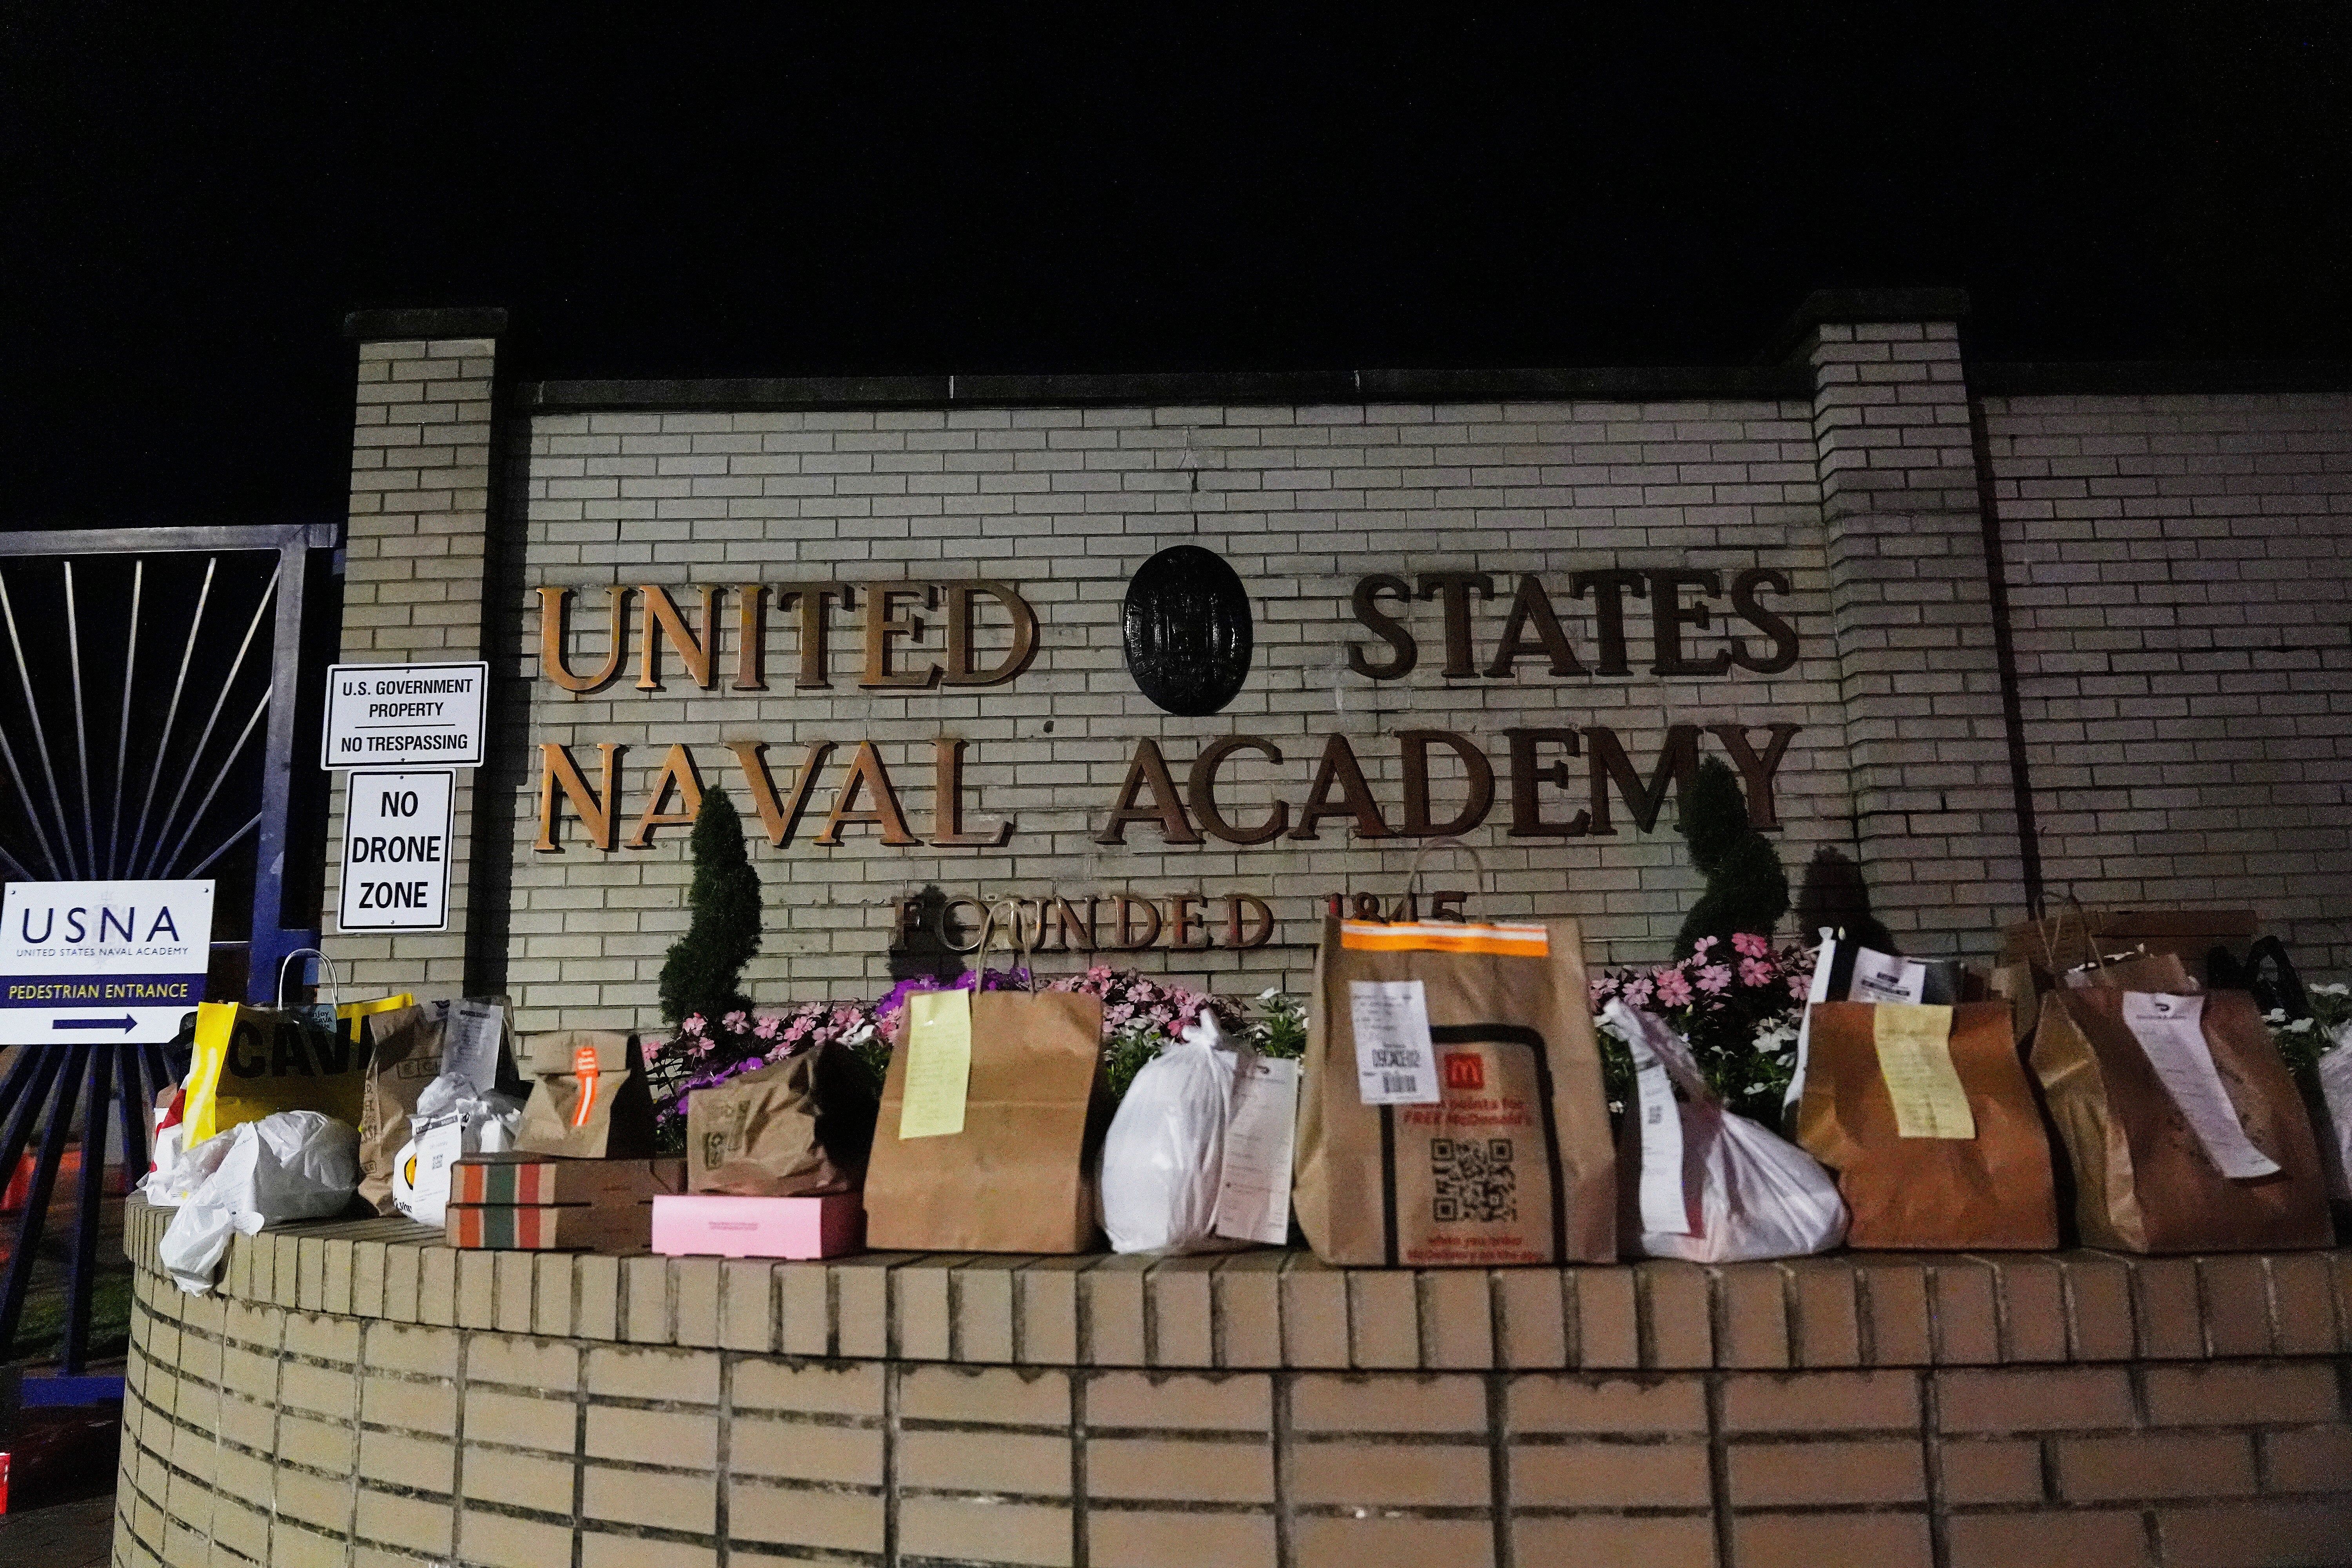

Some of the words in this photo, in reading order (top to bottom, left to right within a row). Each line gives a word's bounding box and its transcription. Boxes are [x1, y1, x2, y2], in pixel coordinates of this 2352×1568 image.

[537, 583, 1039, 693] UNITED
[1348, 568, 1800, 679] STATES
[343, 682, 370, 696] U.S.
[376, 679, 473, 695] GOVERNMENT
[369, 702, 444, 718] PROPERTY
[341, 737, 362, 752] NO
[367, 734, 468, 751] TRESPASSING
[535, 739, 1013, 853] NAVAL
[1095, 724, 1802, 844] ACADEMY
[381, 791, 418, 817] NO
[353, 836, 441, 862] DRONE
[359, 882, 428, 908] ZONE
[22, 906, 180, 943] USNA
[891, 894, 1276, 951] FOUNDED
[16, 949, 56, 957] UNITED
[136, 947, 189, 956] ACADEMY
[9, 984, 100, 999] PEDESTRIAN
[105, 984, 189, 998] ENTRANCE
